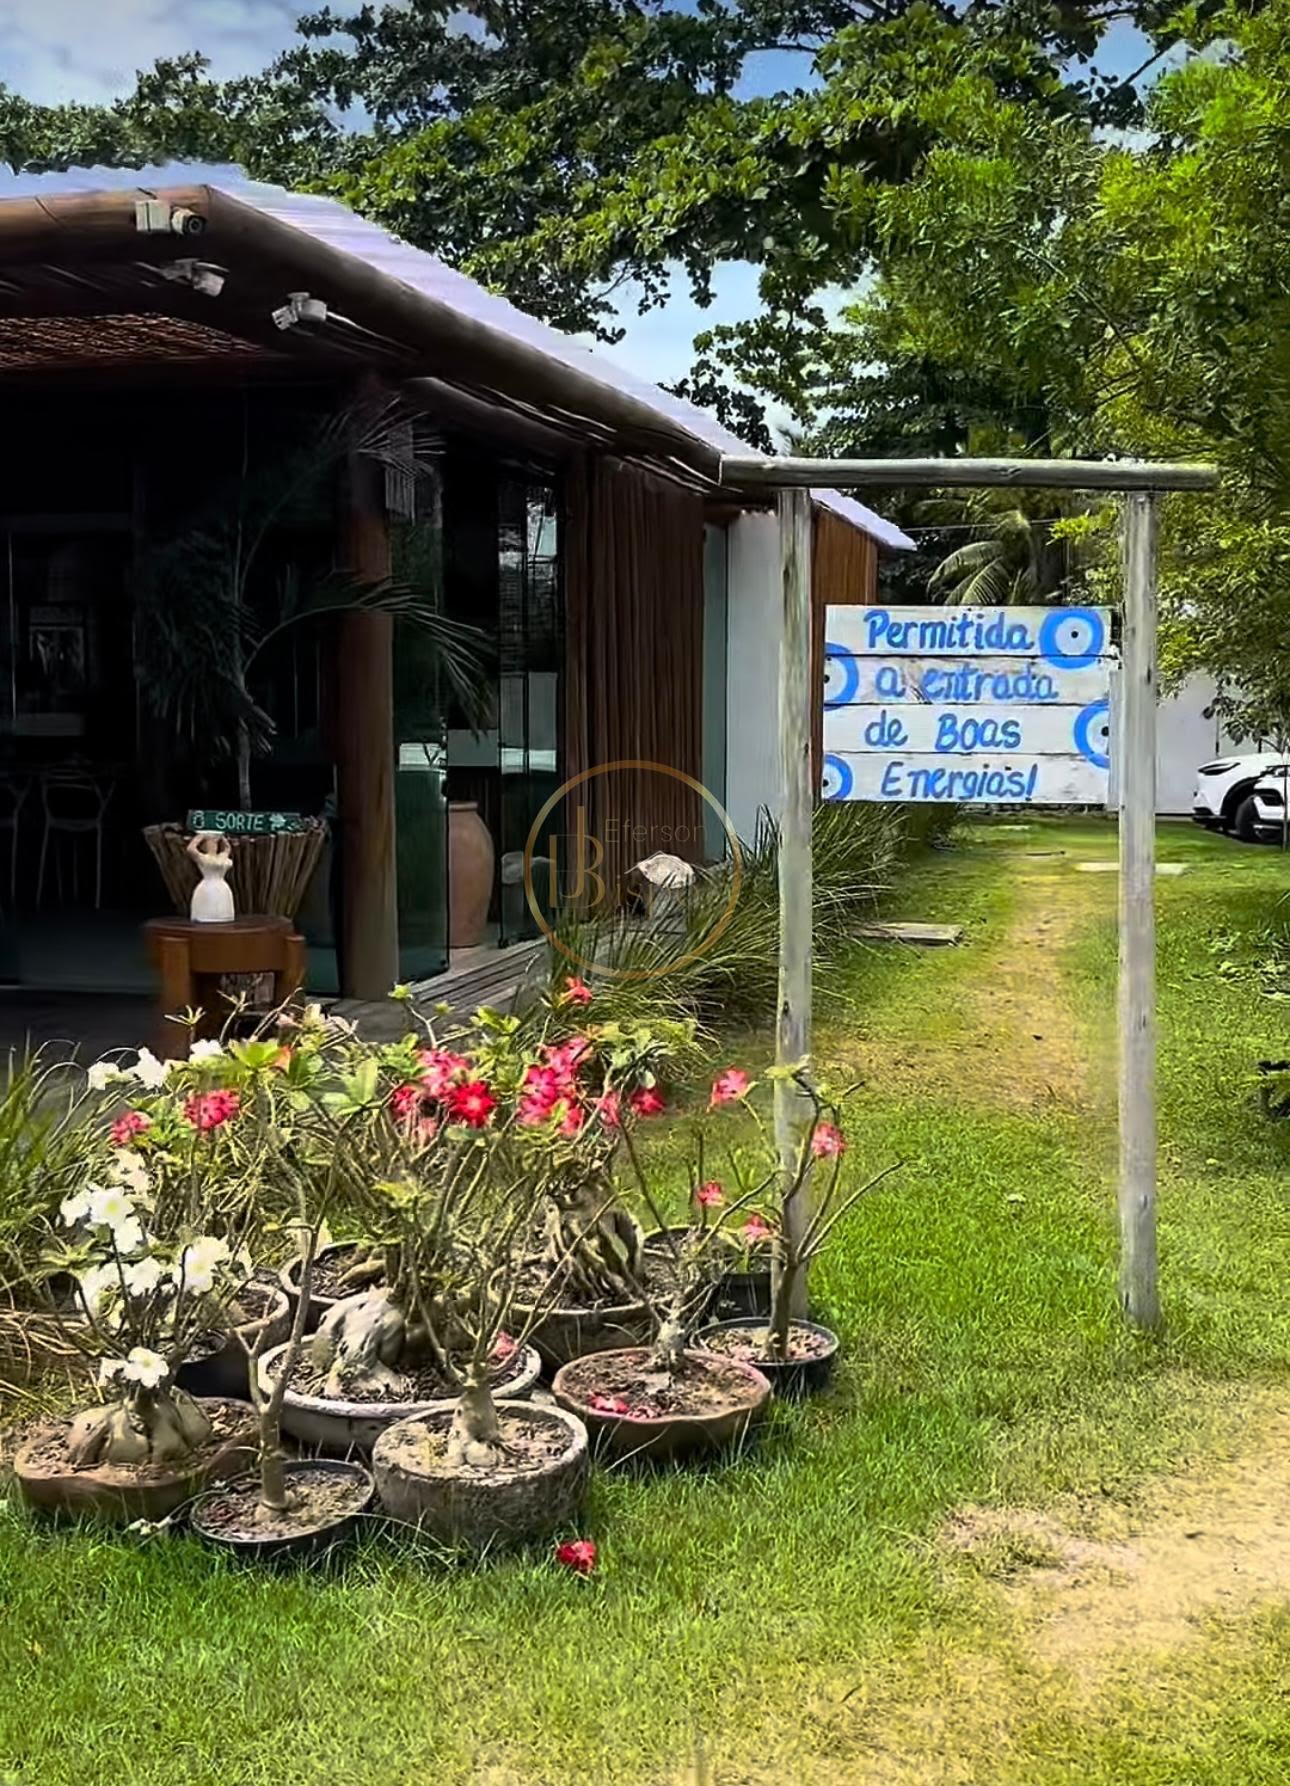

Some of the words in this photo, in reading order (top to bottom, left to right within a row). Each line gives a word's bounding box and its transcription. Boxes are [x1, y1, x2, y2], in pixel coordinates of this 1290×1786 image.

[864, 609, 1035, 650] Permitida
[875, 666, 906, 698] a
[921, 664, 1059, 701] entrada
[864, 709, 908, 747] de
[935, 712, 1021, 752] Boas
[881, 761, 1039, 801] Energias!
[215, 812, 265, 831] SORTE
